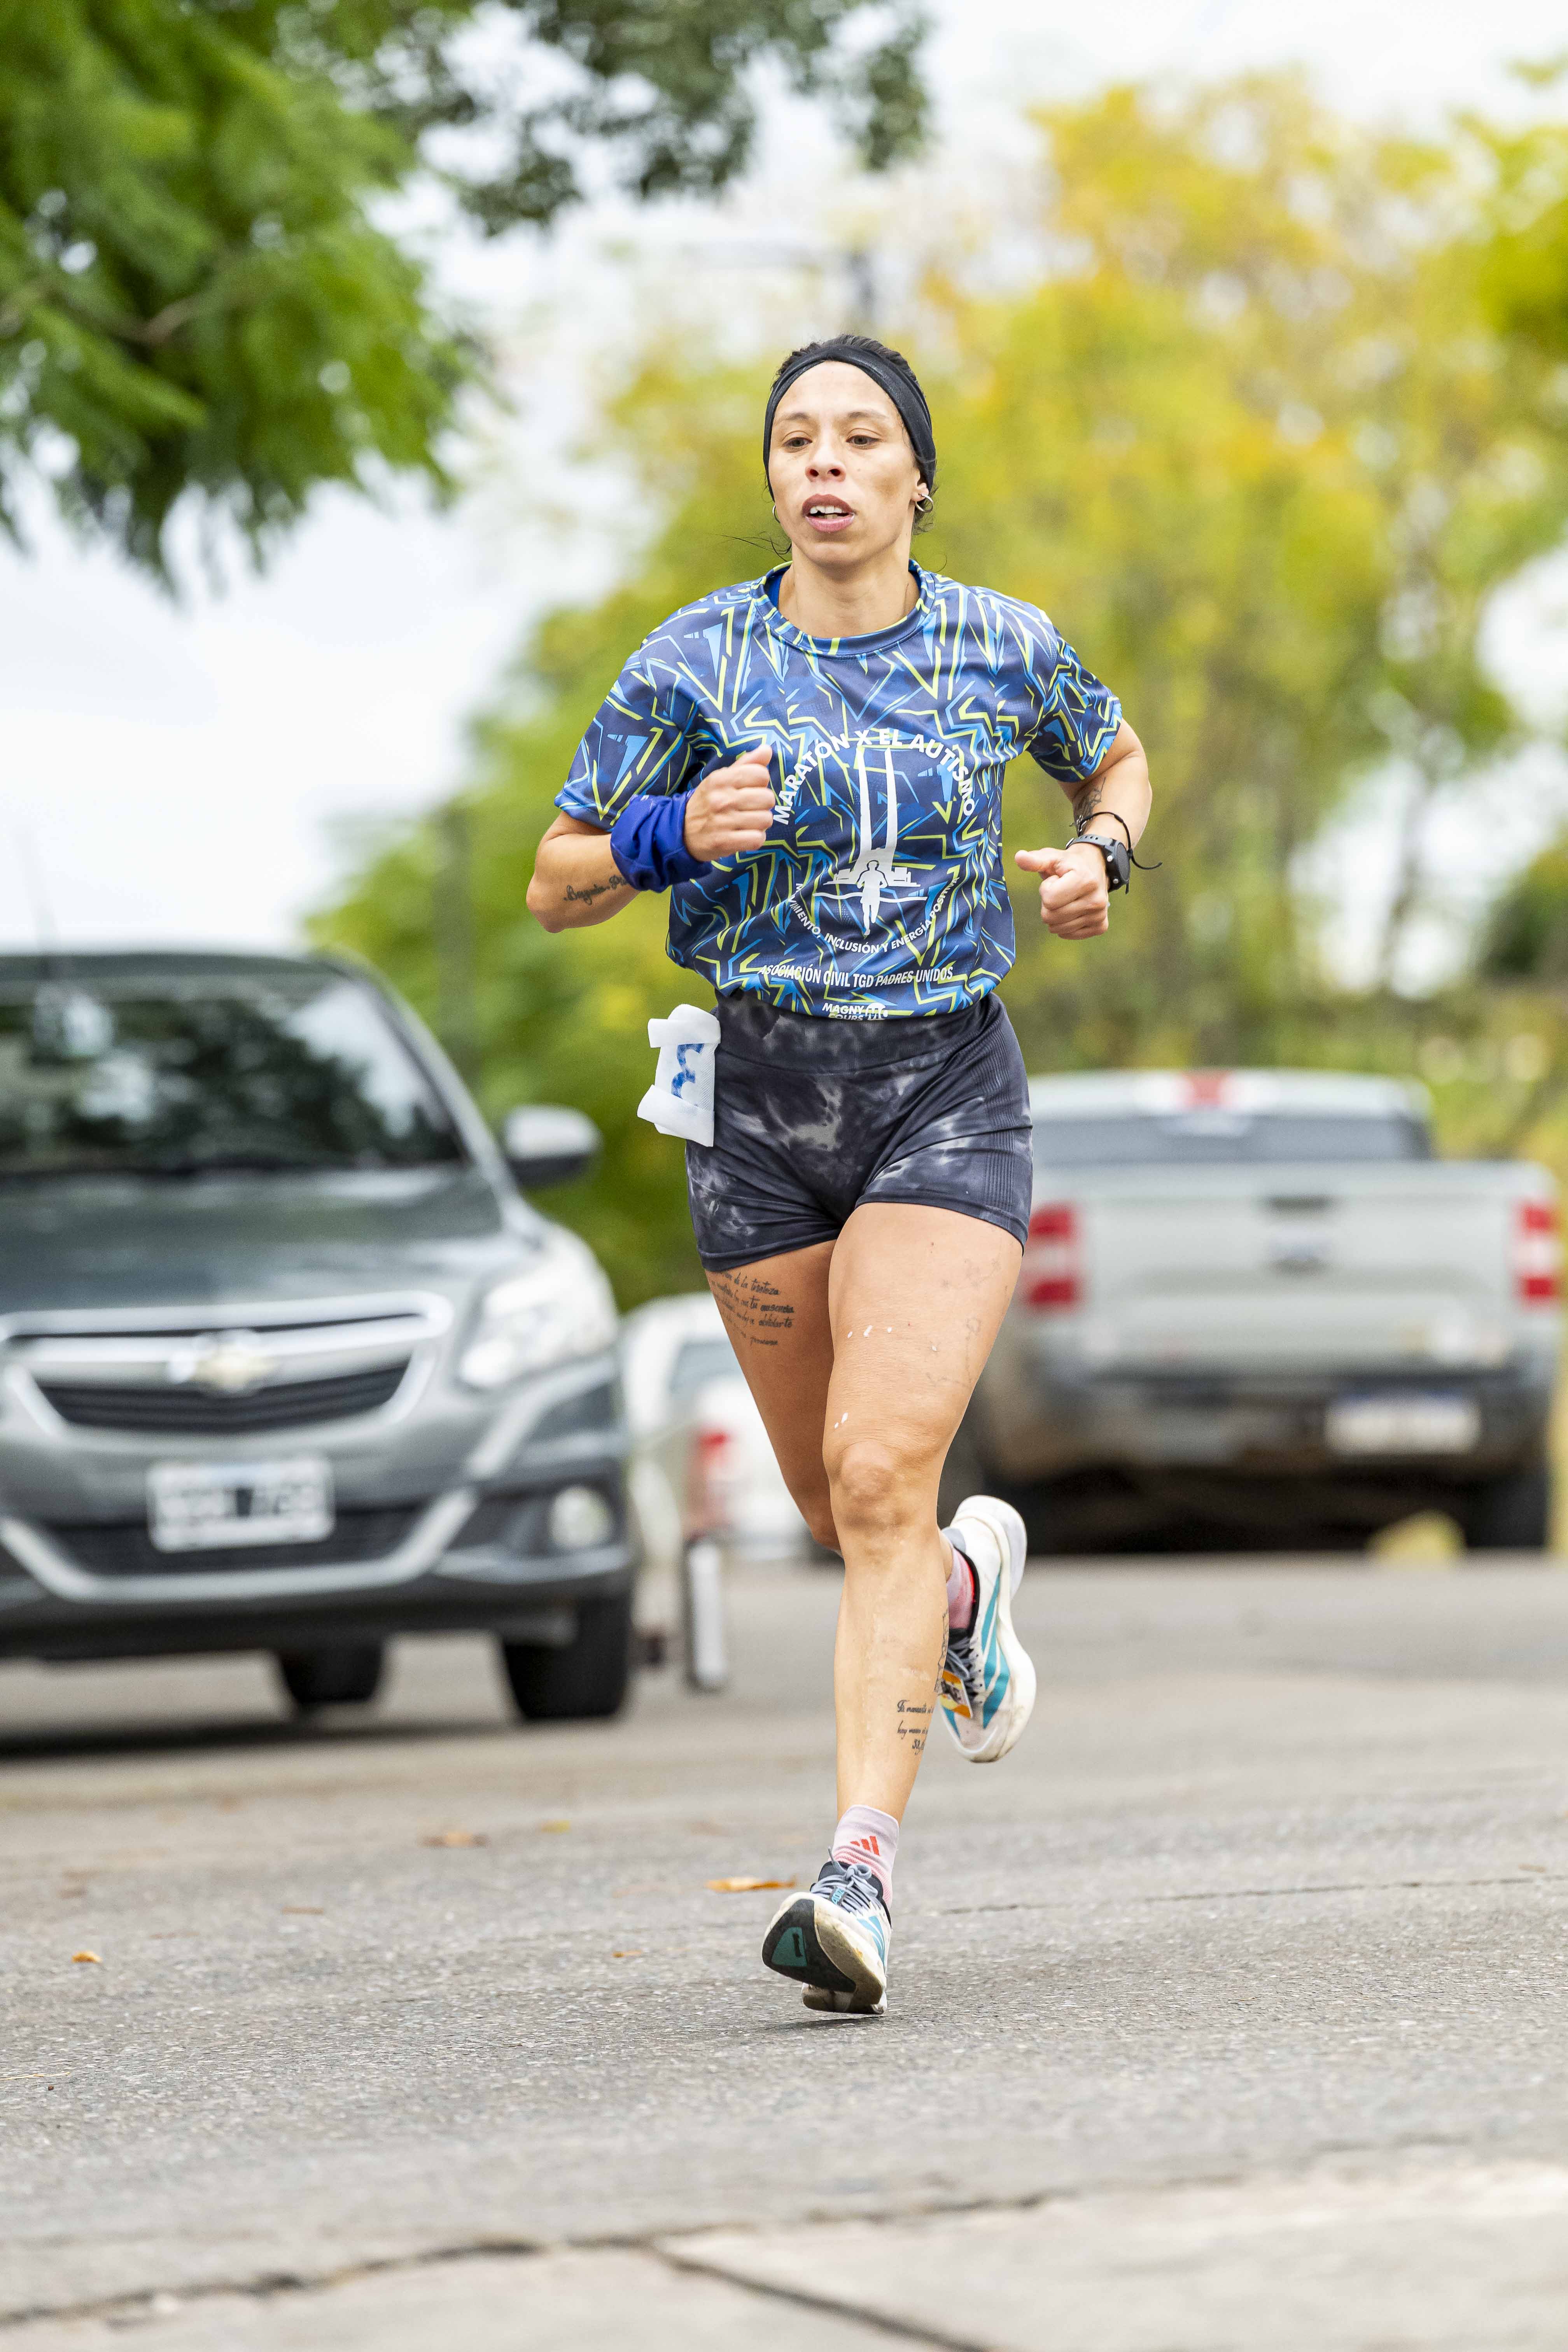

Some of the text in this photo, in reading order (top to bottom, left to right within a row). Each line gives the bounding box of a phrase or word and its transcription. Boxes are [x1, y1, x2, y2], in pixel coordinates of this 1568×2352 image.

[773, 728, 975, 825] MARATÓN X EL AUTISMO
[824, 933, 879, 954] INCLUSIÓN
[883, 943, 889, 952] Y
[891, 919, 932, 949] ENERGÍA
[757, 964, 953, 988] ASOCIACIÓN CIVIL TGD PADRES UNIDOS
[822, 1003, 864, 1015] MAGNY
